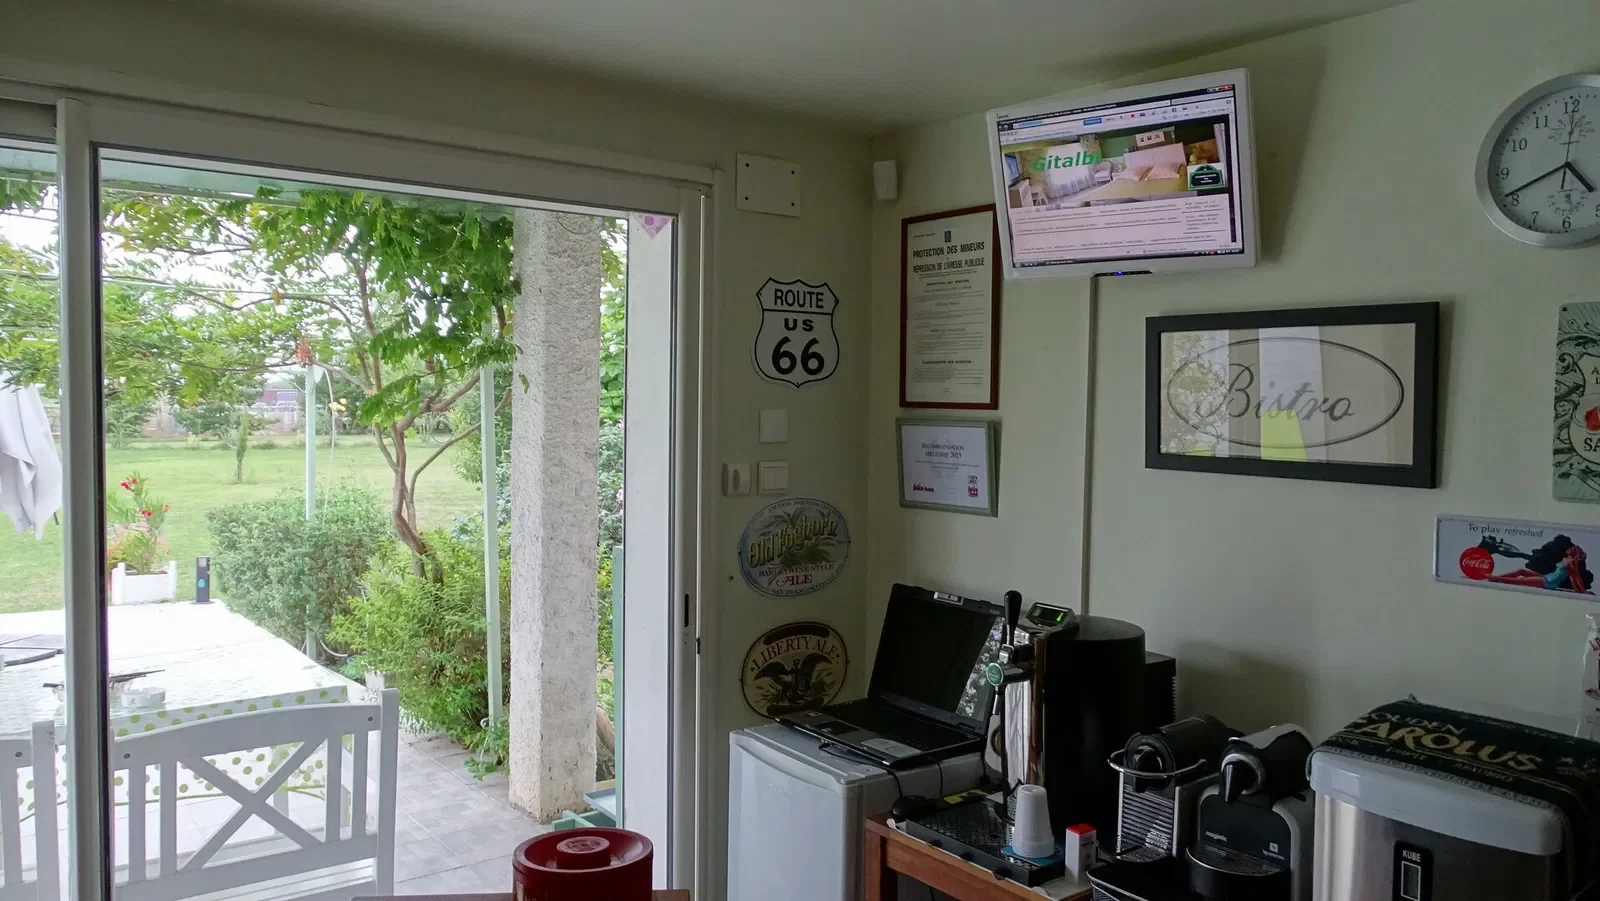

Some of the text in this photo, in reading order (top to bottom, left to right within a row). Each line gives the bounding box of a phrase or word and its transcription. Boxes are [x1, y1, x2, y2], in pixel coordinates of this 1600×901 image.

[1563, 99, 1580, 114] 12
[1534, 115, 1549, 129] 11
[1510, 137, 1528, 152] 10
[1500, 167, 1510, 180] 9
[1511, 193, 1520, 206] 8
[1531, 211, 1539, 225] 7
[1562, 216, 1571, 230] 6
[913, 241, 985, 259] PROTECTION DES MINEURS
[964, 257, 985, 267] PUBLIQUE
[774, 288, 824, 309] ROUTE
[783, 317, 814, 332] US
[772, 336, 825, 376] 66
[1196, 363, 1355, 421] Bistro
[1468, 523, 1544, 538] To play refreshed
[748, 534, 775, 568] Old
[776, 573, 813, 587] ALE
[752, 636, 837, 670] LIBERTY ALE
[1362, 712, 1466, 736] OUDEN
[1402, 849, 1421, 863] KUBE
